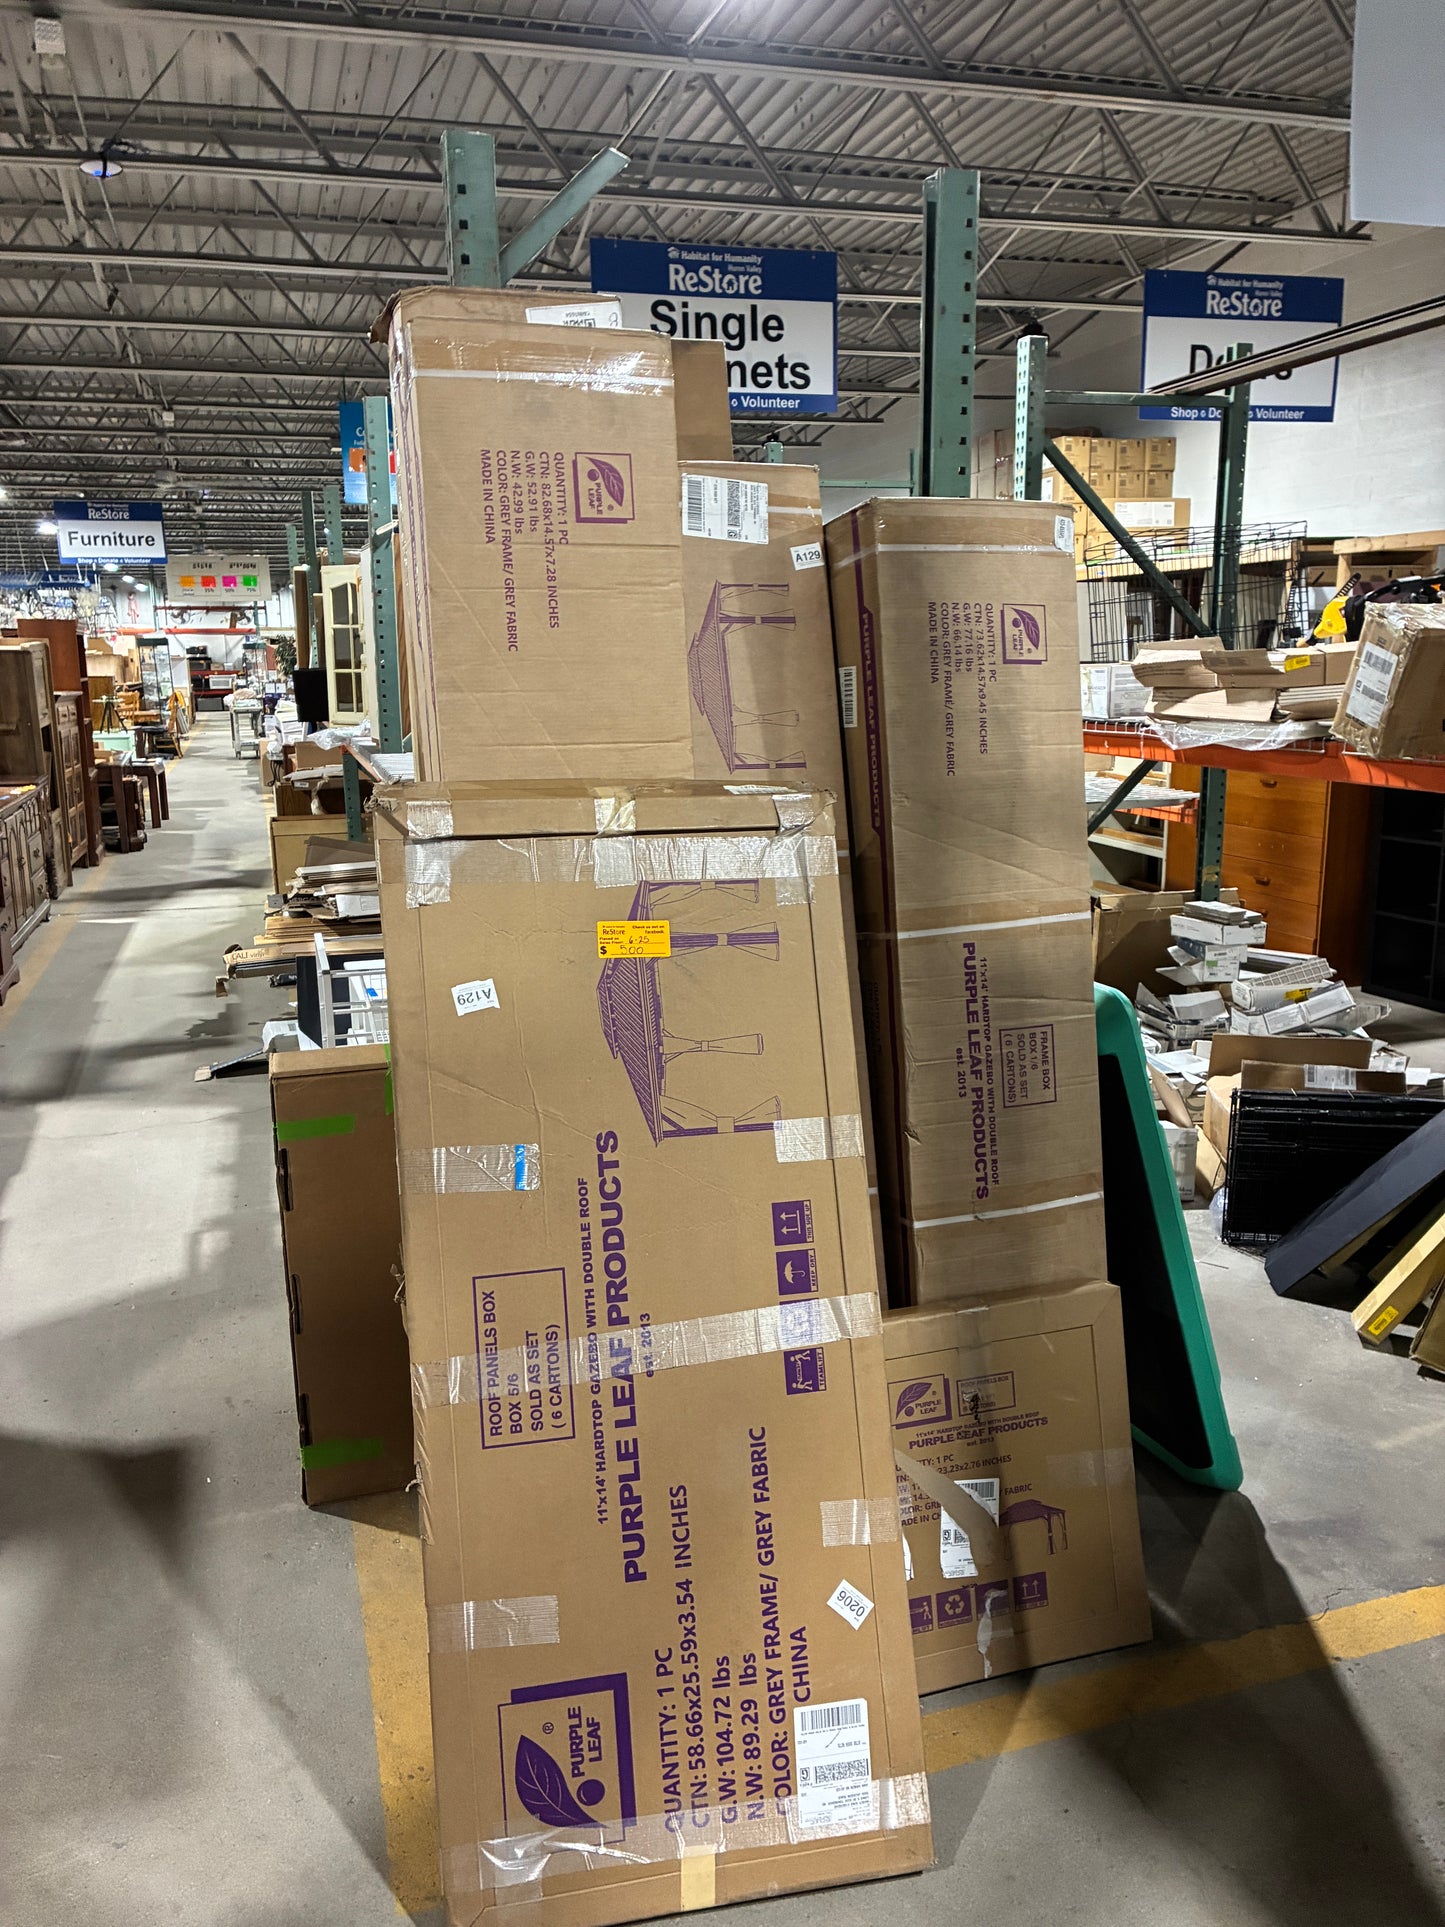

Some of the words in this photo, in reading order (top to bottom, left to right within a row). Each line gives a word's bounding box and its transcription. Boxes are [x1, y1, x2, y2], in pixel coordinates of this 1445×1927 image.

[681, 250, 710, 261] Habitat
[711, 252, 723, 262] for
[724, 253, 762, 264] Humanity
[668, 264, 763, 294] ReStore
[1218, 278, 1241, 287] Habitat
[1242, 279, 1252, 288] for
[1252, 280, 1283, 290] Humanity
[1206, 290, 1283, 317] ReStore
[650, 300, 785, 351] Single
[741, 396, 800, 408] Volunteer
[1170, 407, 1199, 420] Shop
[1256, 408, 1304, 420] Volunteer
[480, 449, 492, 485] MADE
[496, 450, 508, 493] COLOR:
[511, 450, 521, 479] N.W:
[525, 451, 536, 479] G.W:
[539, 452, 550, 479] CTN:
[483, 488, 493, 502] IN
[512, 482, 524, 514] 42.99
[527, 482, 538, 516] 52.91
[554, 452, 566, 516] QUANTITY:
[88, 508, 130, 519] ReStore
[484, 507, 496, 544] CHINA
[499, 495, 511, 526] GREY
[514, 517, 525, 534] lbs
[529, 516, 539, 532] lbs
[68, 531, 155, 546] Furniture
[541, 483, 556, 582] 82.68x14.57x7.28
[559, 530, 568, 545] PC
[501, 529, 514, 575] FRAME/
[795, 550, 821, 563] A129
[504, 578, 515, 608] GREY
[547, 585, 560, 629] INCHES
[928, 602, 937, 632] MADE
[941, 602, 949, 639] COLOR:
[952, 602, 960, 626] N.W:
[963, 603, 971, 625] G.W:
[974, 603, 982, 626] CTN:
[985, 603, 996, 658] QUANTITY:
[506, 611, 518, 652] FABRIC
[862, 613, 872, 682] PURPLE
[930, 636, 937, 646] IN
[953, 630, 962, 655] 66.14
[965, 629, 973, 654] 77.16
[930, 650, 939, 683] CHINA
[943, 641, 951, 667] GREY
[955, 659, 963, 672] lbs
[976, 629, 986, 714] 73.62x14.57x9.45
[989, 669, 997, 682] PC
[867, 686, 876, 729] LEAF
[944, 671, 953, 710] FRAME/
[945, 713, 954, 738] GREY
[979, 717, 988, 754] INCHES
[946, 742, 955, 776] FABRIC
[869, 734, 880, 828] PRODUCTS
[600, 946, 607, 955] $
[620, 945, 644, 954] 500
[457, 988, 491, 1006] A129
[963, 942, 979, 1023] PURPLE
[982, 995, 991, 1044] HARDTOP
[968, 1029, 982, 1081] LEAF
[1017, 1034, 1026, 1061] SOLD
[1029, 1032, 1037, 1053] BOX
[1040, 1031, 1049, 1066] FRAME
[985, 1046, 993, 1085] GAZEBO
[1006, 1051, 1016, 1103] CARTONS)
[1019, 1064, 1027, 1077] AS
[957, 1070, 966, 1098] 2013
[1020, 1081, 1028, 1098] SET
[970, 1086, 989, 1200] PRODUCTS
[988, 1115, 998, 1157] DOUBLE
[990, 1159, 999, 1185] ROOF
[578, 1178, 590, 1218] ROOF
[596, 1130, 630, 1327] PRODUCTS
[581, 1222, 594, 1284] DOUBLE
[482, 1290, 496, 1323] BOX
[584, 1288, 596, 1328] WITH
[526, 1331, 539, 1359] SET
[640, 1312, 652, 1348] 2013
[484, 1328, 500, 1387] PANELS
[528, 1364, 540, 1384] AS
[545, 1324, 562, 1406] CARTONS)
[586, 1332, 601, 1395] GAZEBO
[507, 1373, 519, 1396] 5/6
[609, 1338, 637, 1428] LEAF
[488, 1393, 502, 1436] ROOF
[509, 1402, 522, 1434] BOX
[530, 1389, 543, 1431] SOLD
[915, 1400, 941, 1410] PURPLE
[920, 1406, 937, 1415] LEAF
[986, 1418, 1001, 1426] WITH
[1002, 1414, 1024, 1424] DOUBLE
[592, 1400, 606, 1473] HARDTOP
[909, 1433, 955, 1450] PURPLE
[956, 1427, 987, 1440] LEAF
[988, 1416, 1048, 1435] PRODUCTS
[749, 1426, 770, 1503] FABRIC
[943, 1454, 954, 1462] PC
[982, 1455, 1013, 1467] INCHES
[1005, 1483, 1032, 1495] FABRIC
[616, 1438, 647, 1583] PURPLE
[669, 1484, 692, 1568] INCHES
[920, 1514, 929, 1522] IN
[754, 1510, 775, 1566] GREY
[760, 1573, 782, 1660] FRAME/
[836, 1590, 865, 1617] 0206
[655, 1648, 674, 1677] PC
[676, 1578, 706, 1770] 58.66x25.59x3.54
[712, 1656, 731, 1689] lbs
[739, 1652, 758, 1686] lbs
[790, 1626, 811, 1703] CHINA
[657, 1688, 675, 1697] 1
[766, 1667, 786, 1724] GREY
[568, 1706, 585, 1778] PURPLE
[586, 1717, 602, 1762] LEAF
[713, 1696, 734, 1766] 104.72
[740, 1699, 761, 1759] 89.29
[659, 1704, 685, 1832] QUANTITY:
[771, 1731, 793, 1816] COLOR:
[691, 1773, 710, 1828] CTN:
[718, 1769, 738, 1824] G.W:
[745, 1764, 765, 1821] N.W:
